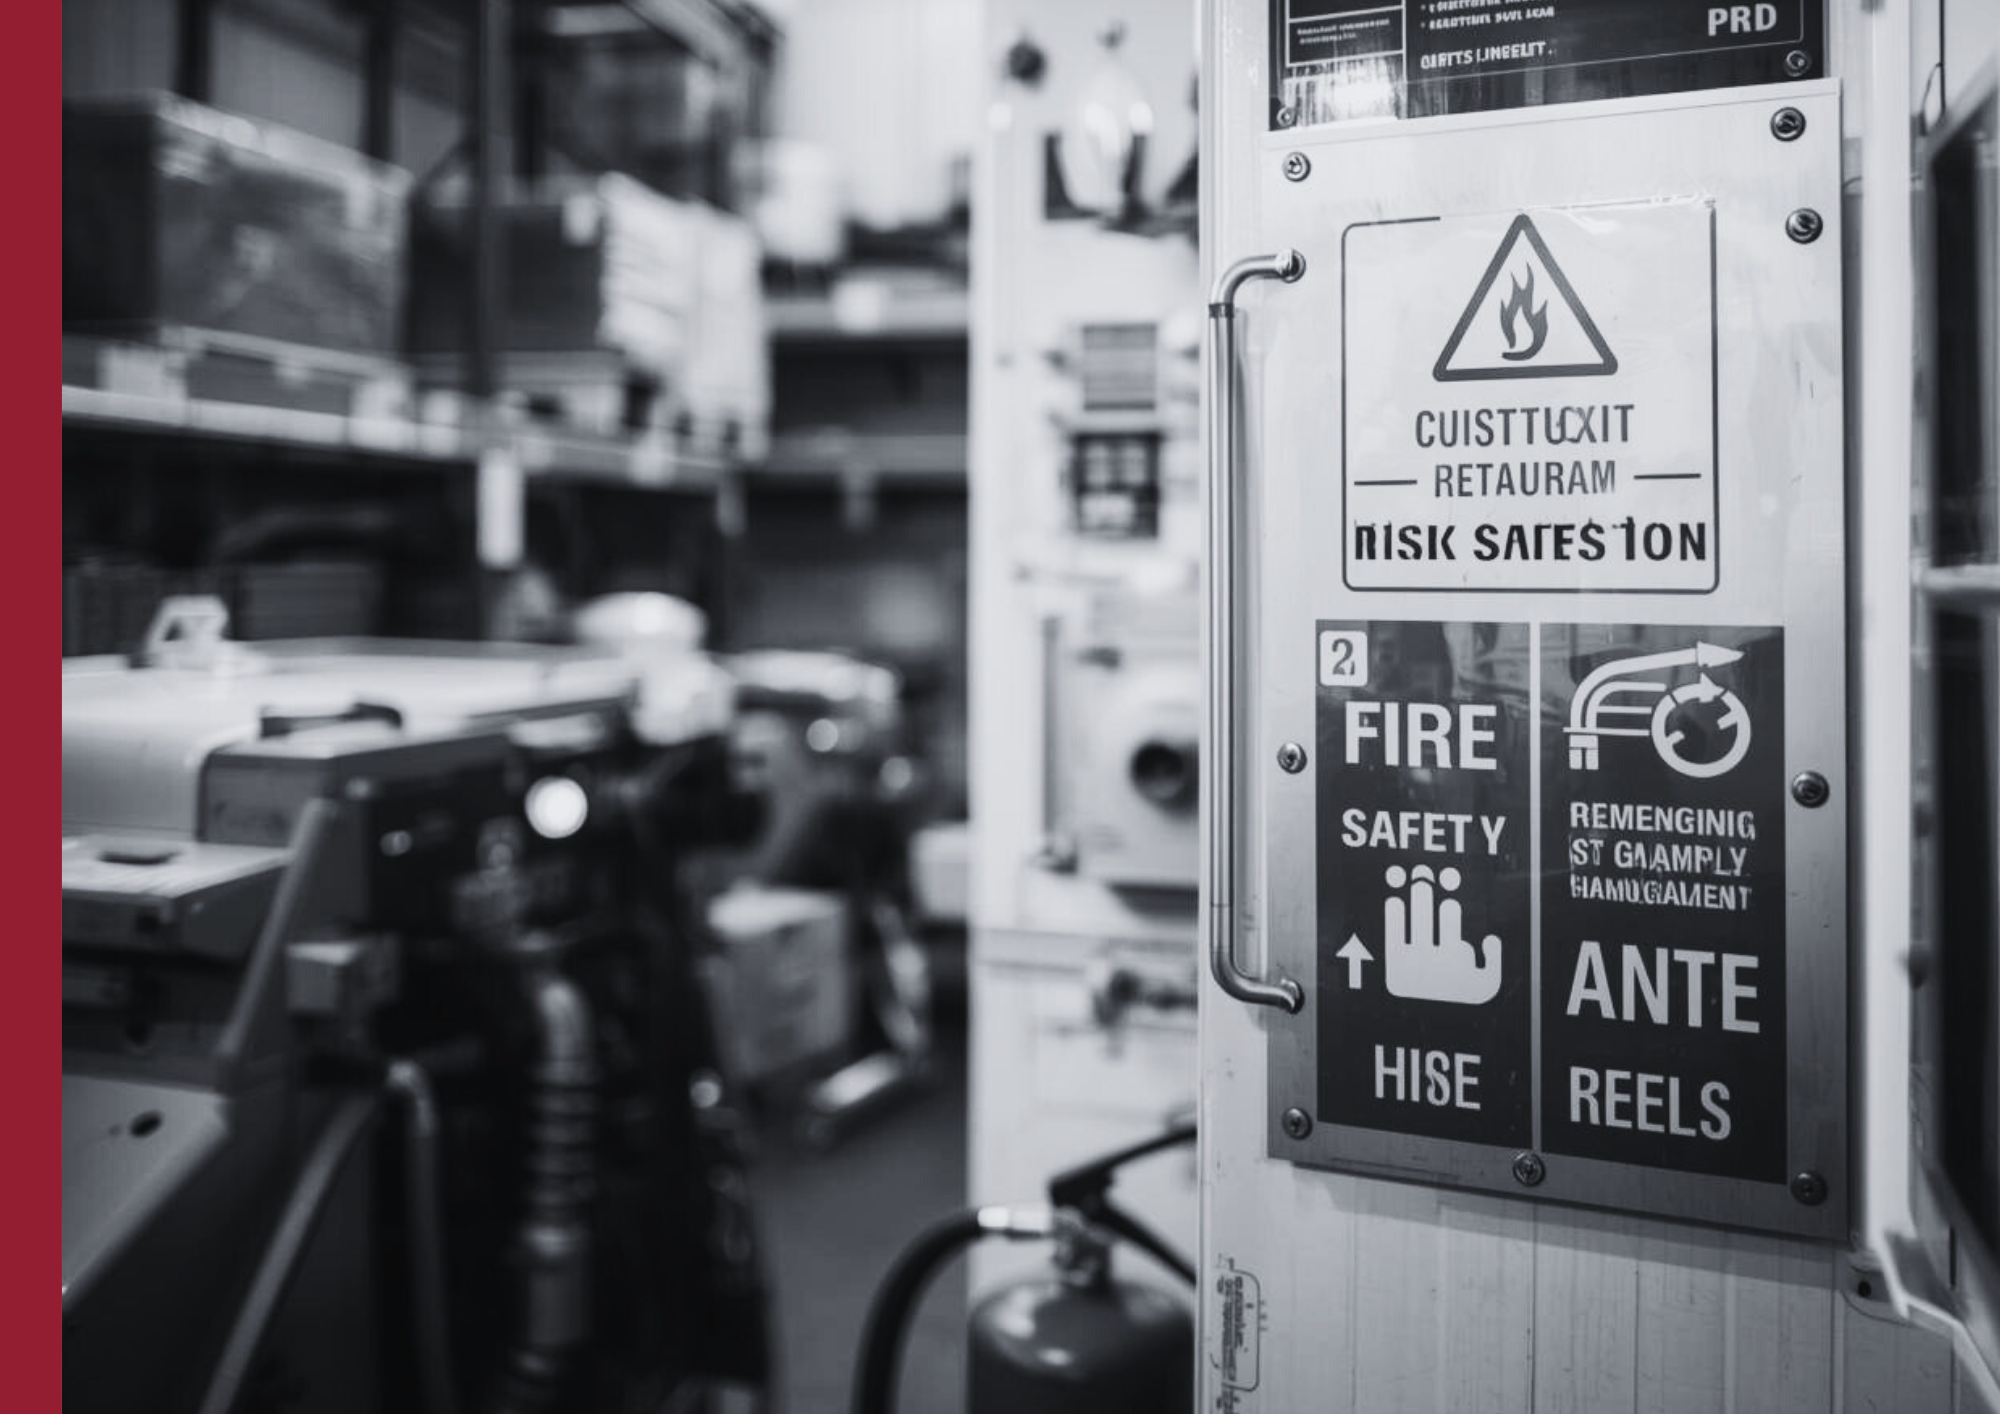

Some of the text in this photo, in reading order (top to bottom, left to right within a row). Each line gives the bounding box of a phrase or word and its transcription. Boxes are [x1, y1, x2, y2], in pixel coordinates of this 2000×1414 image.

[1707, 4, 1777, 37] PRD
[1345, 701, 1497, 770] FIRE
[1341, 808, 1506, 855] SAFETY
[1566, 940, 1760, 1033] ANTE
[1374, 1044, 1481, 1110] HISE
[1570, 1066, 1732, 1141] REELS
